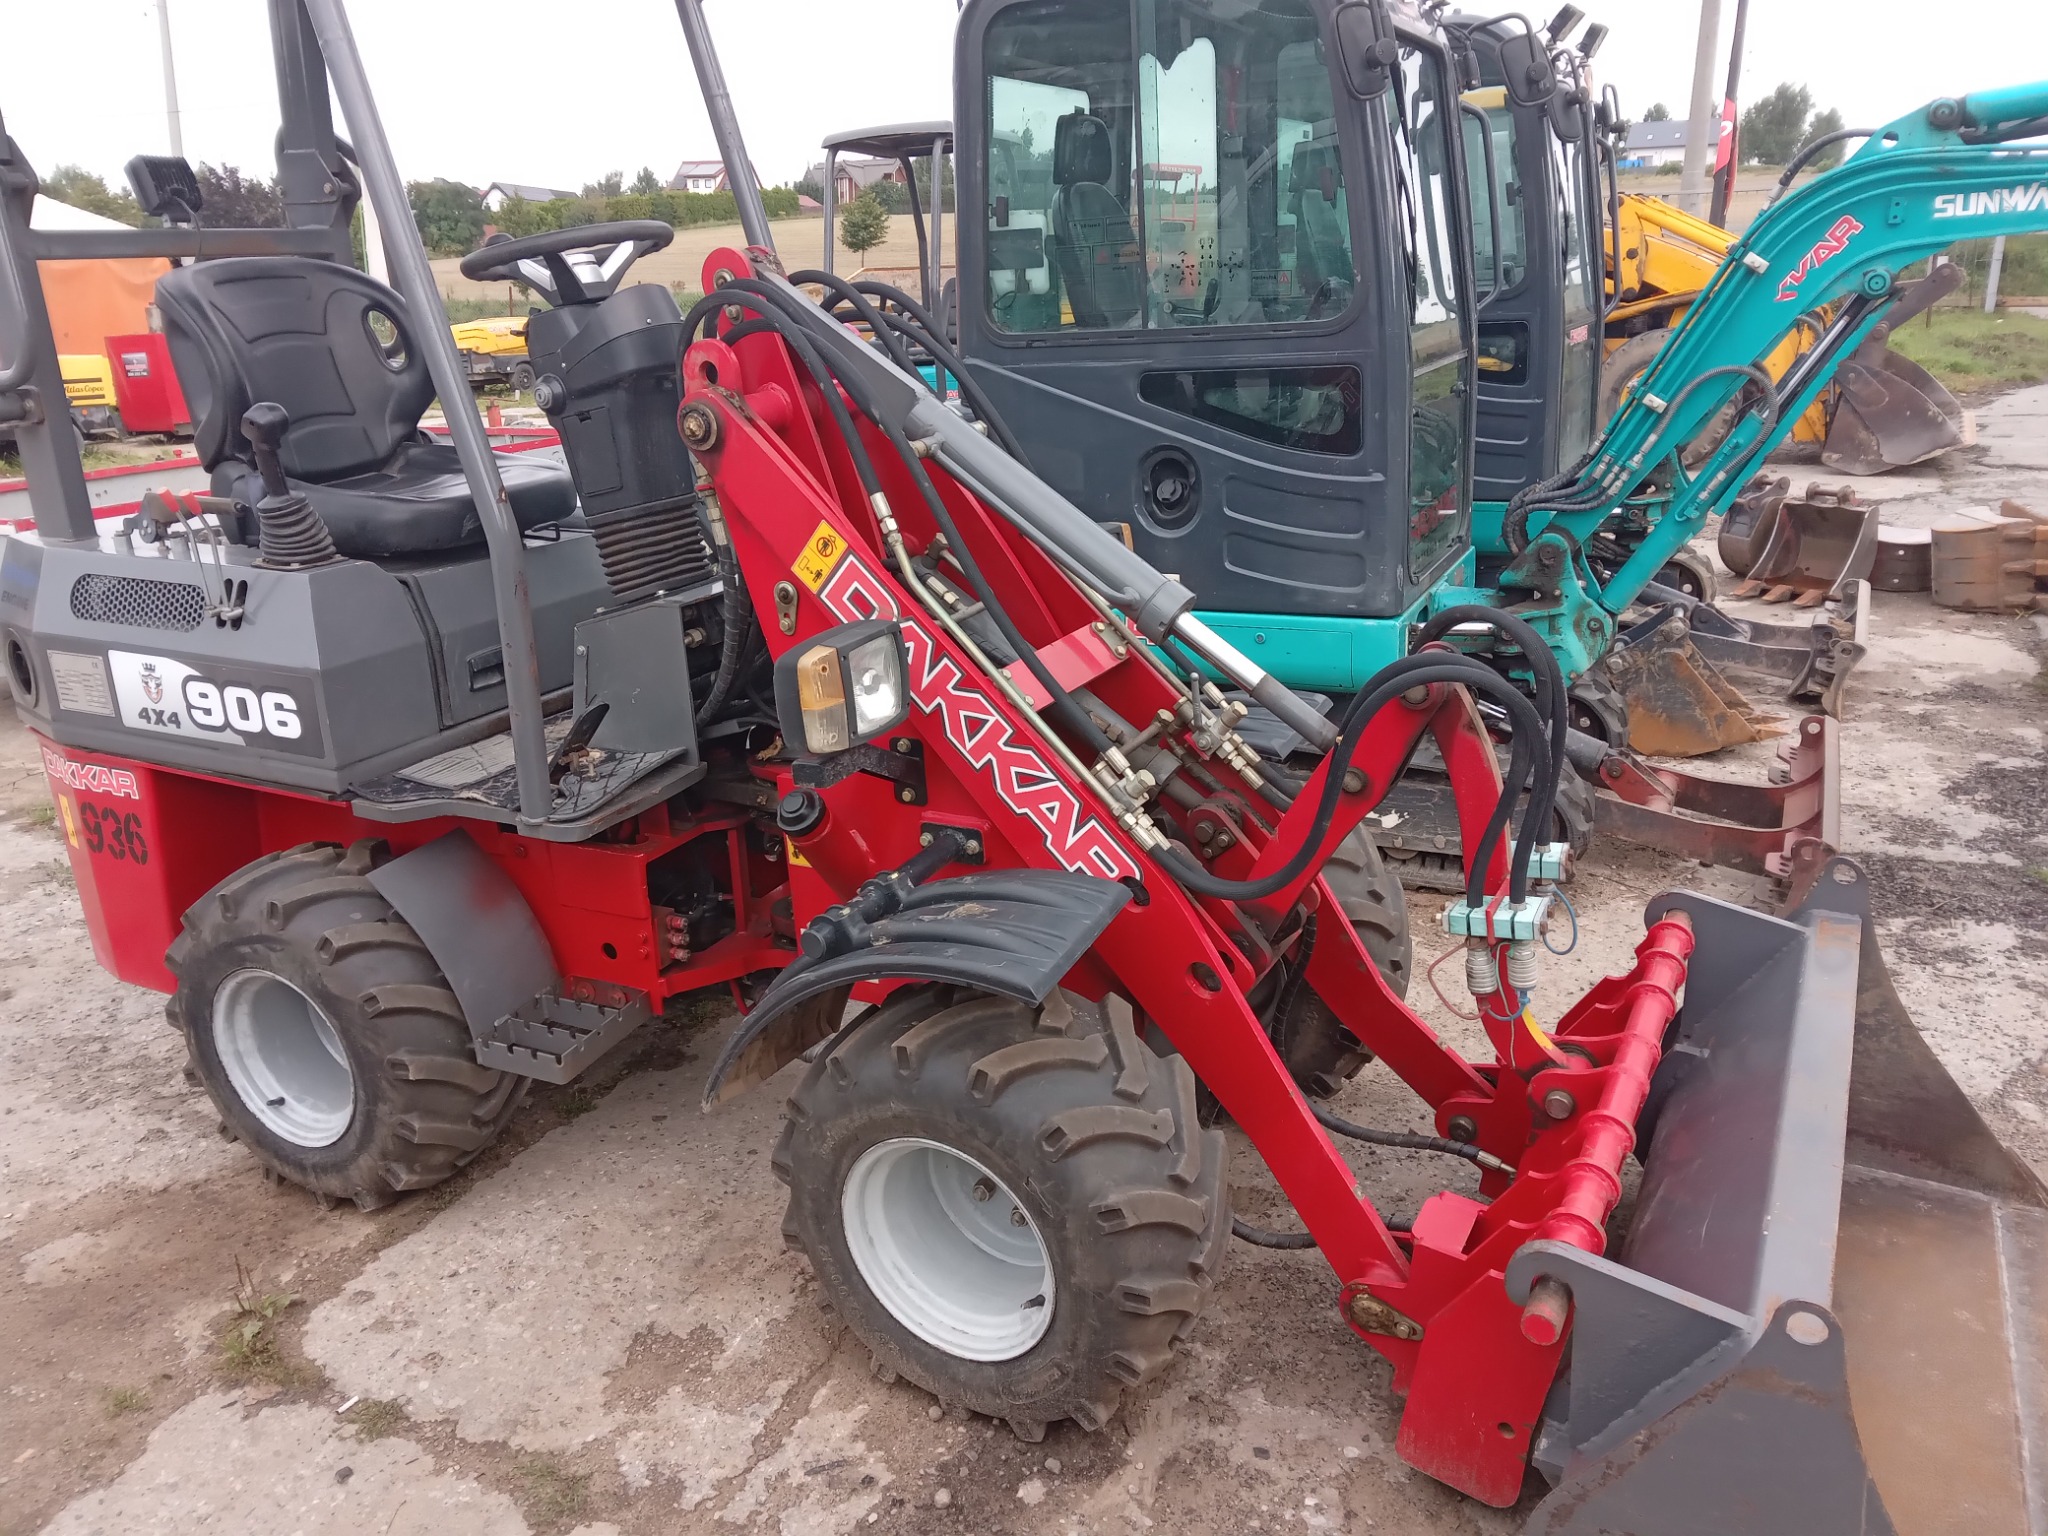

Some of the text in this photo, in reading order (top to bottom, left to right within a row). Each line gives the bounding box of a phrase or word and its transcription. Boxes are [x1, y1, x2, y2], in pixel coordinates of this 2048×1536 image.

[84, 385, 104, 393] Copco
[185, 680, 301, 740] 906
[42, 747, 139, 800] DAKKAR
[80, 802, 149, 865] 936
